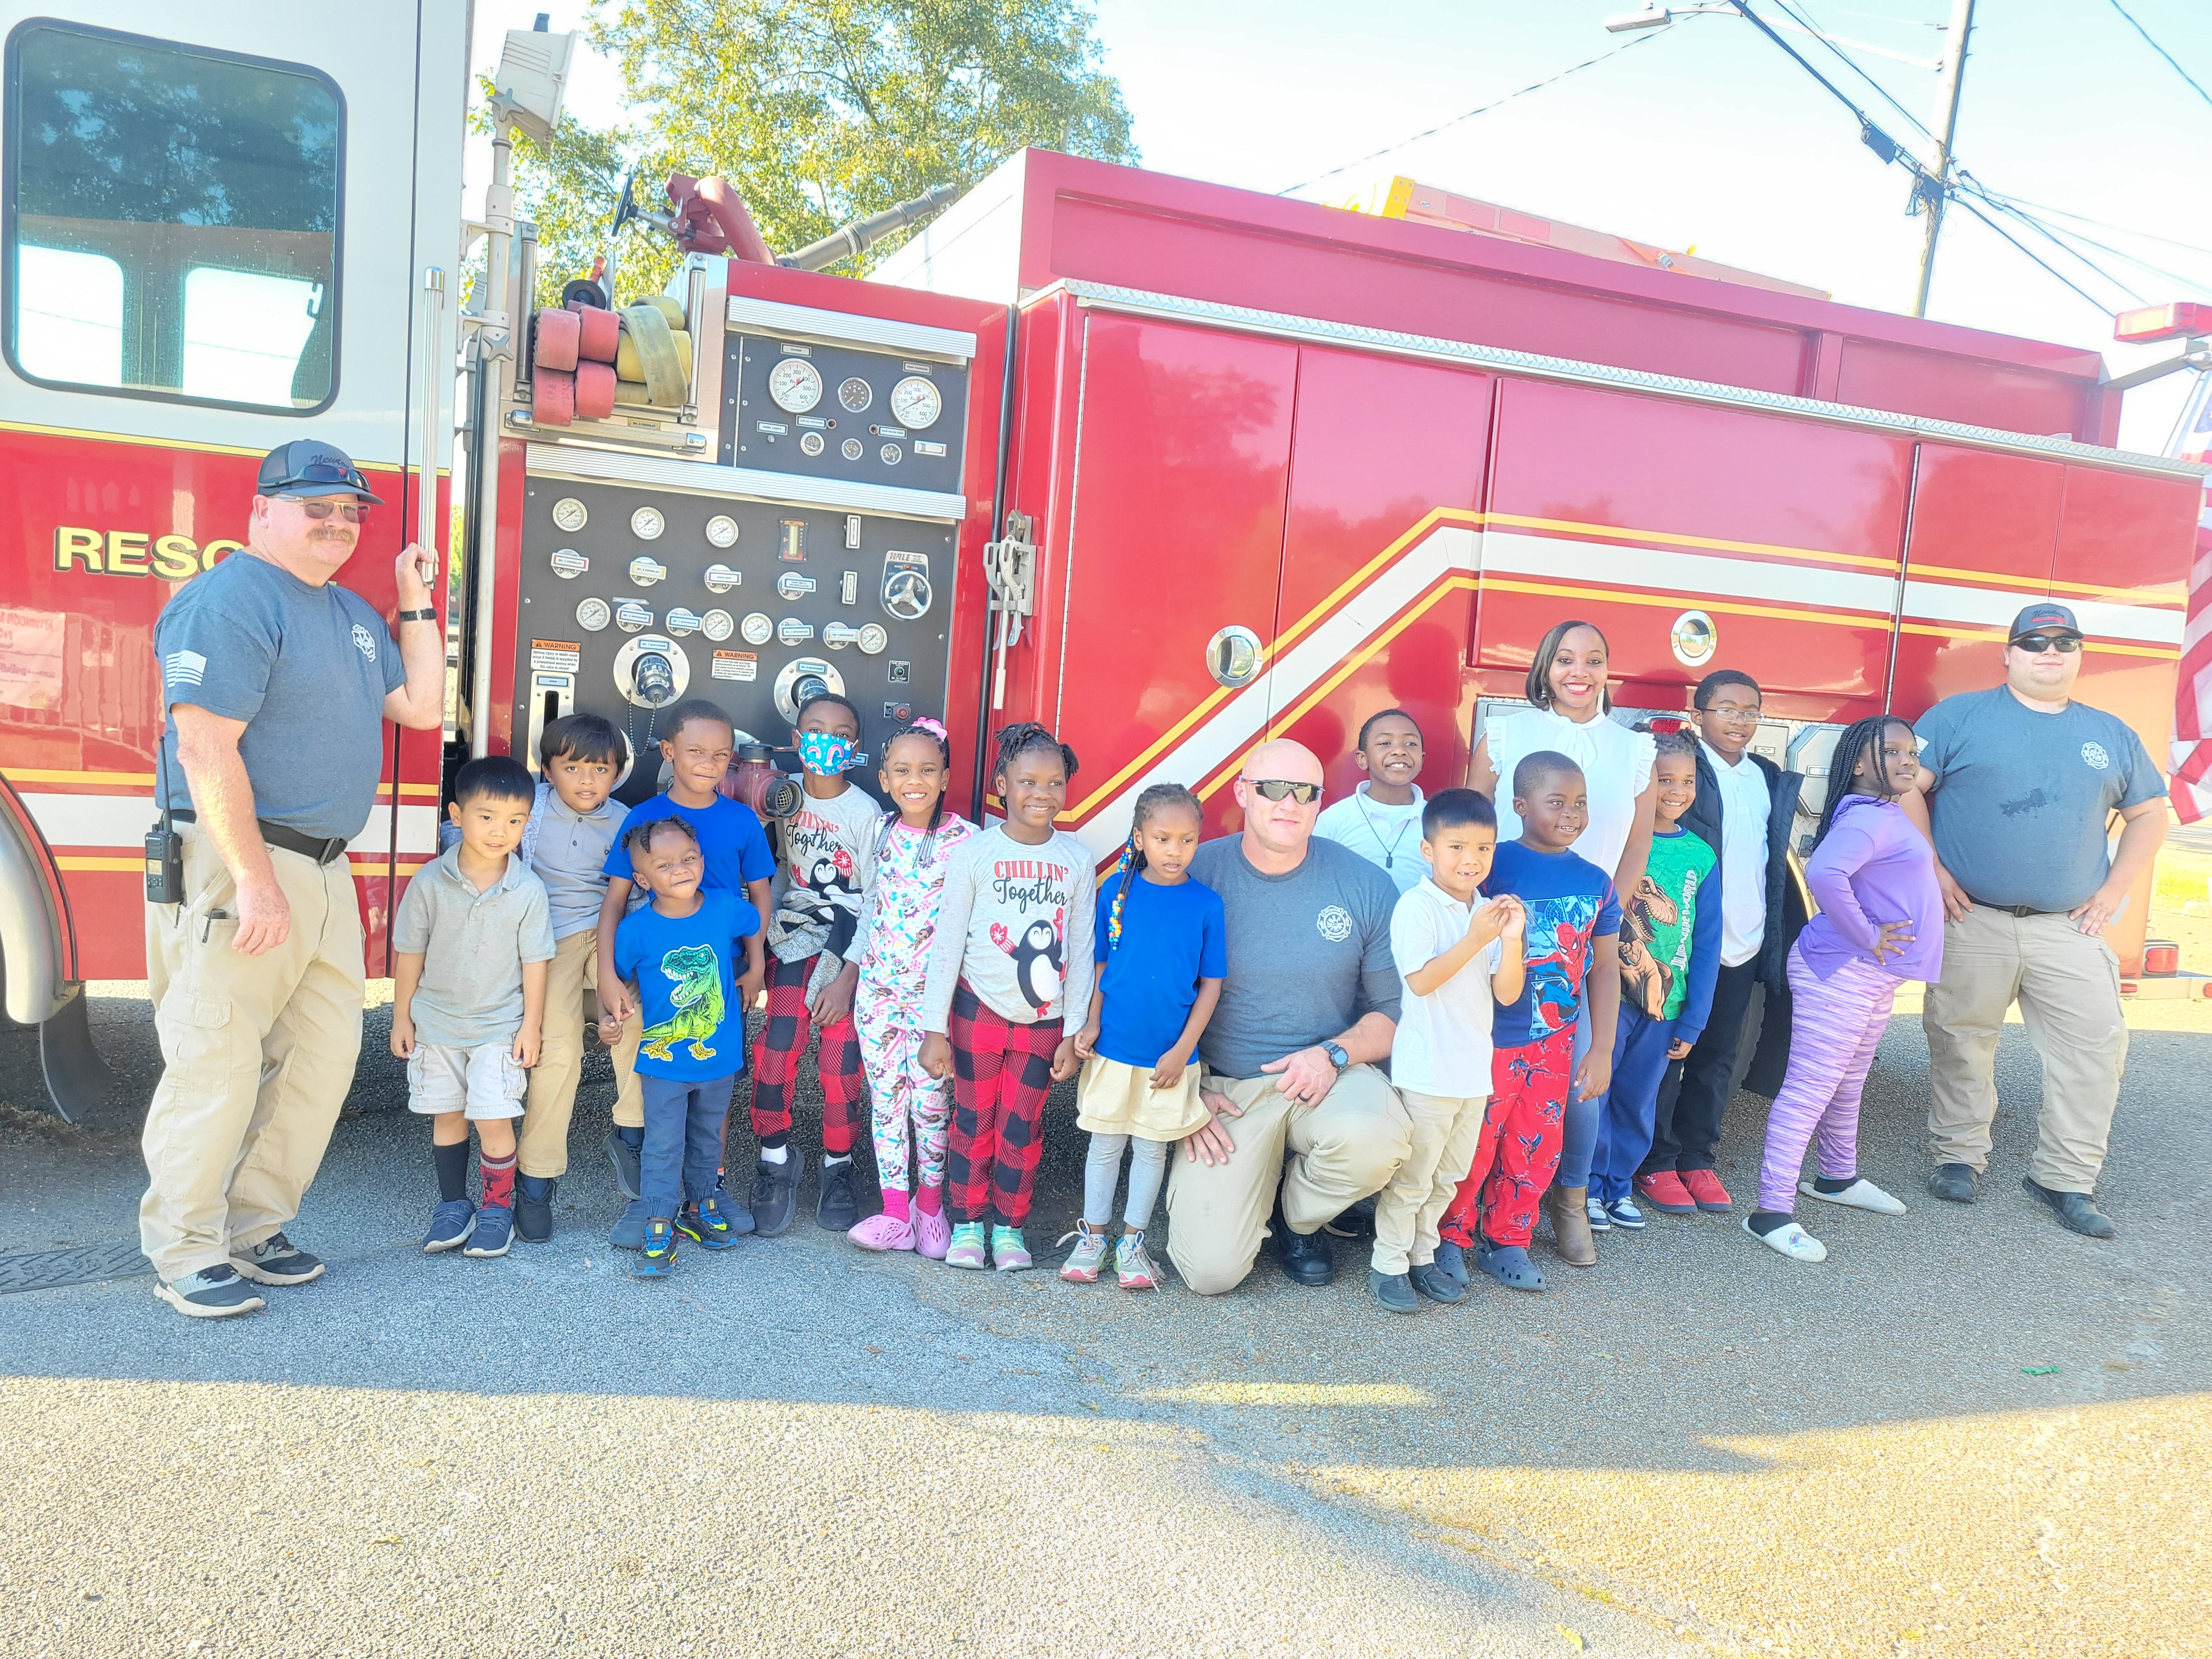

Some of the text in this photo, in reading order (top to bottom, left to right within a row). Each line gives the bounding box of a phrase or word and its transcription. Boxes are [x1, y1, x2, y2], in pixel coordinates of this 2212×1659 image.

[890, 552, 911, 561] HALE
[2032, 610, 2064, 618] Newton
[994, 860, 1069, 882] CHILLIN'
[992, 877, 1068, 913] Together
